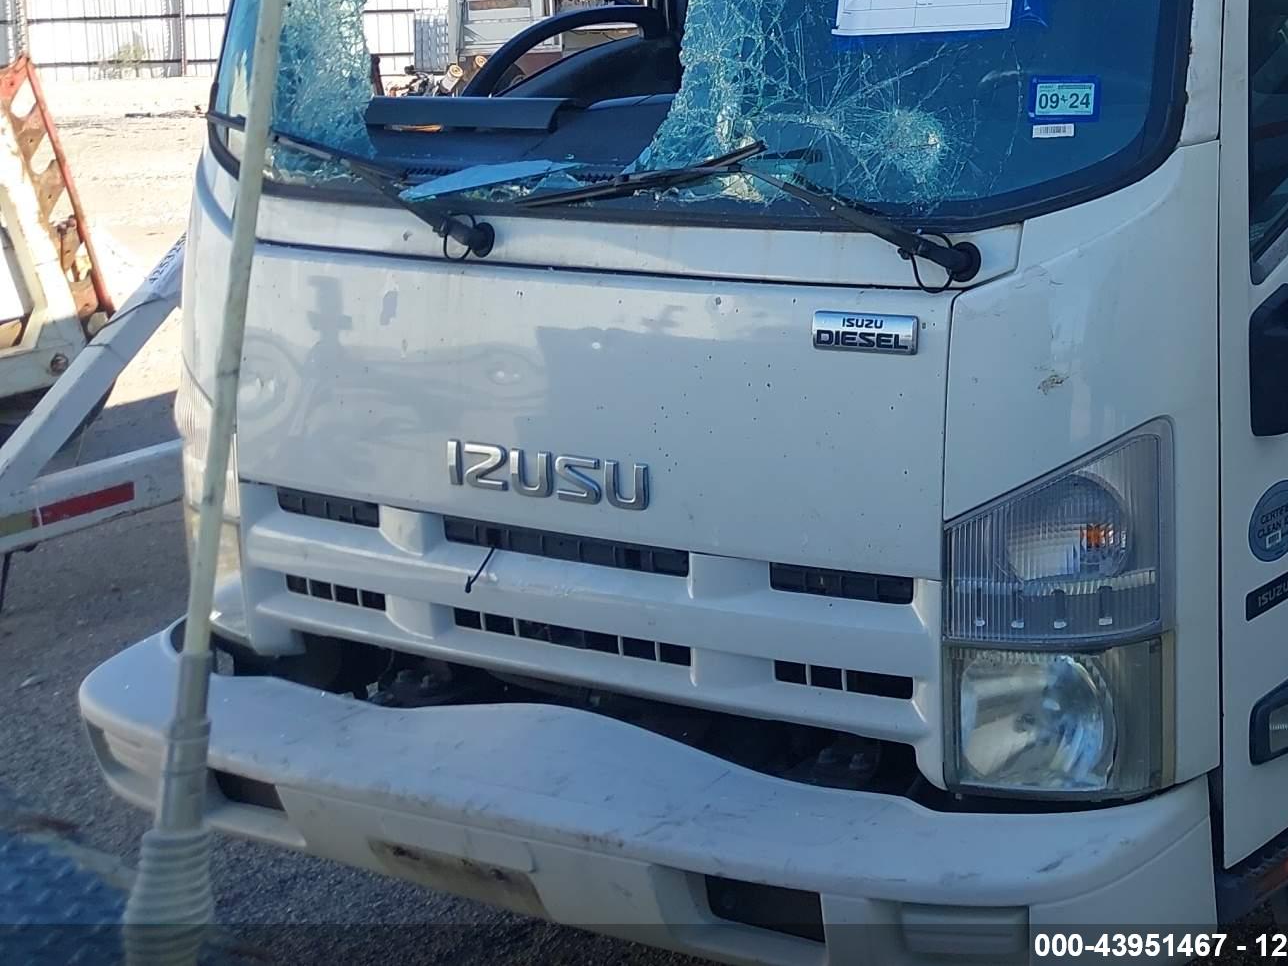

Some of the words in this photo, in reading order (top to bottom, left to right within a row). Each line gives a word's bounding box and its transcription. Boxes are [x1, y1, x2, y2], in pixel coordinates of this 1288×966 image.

[1039, 93, 1060, 109] 09
[1069, 93, 1091, 108] 24
[841, 316, 884, 330] ISUZU
[816, 329, 910, 351] DIESEL
[447, 438, 650, 511] IZUSU
